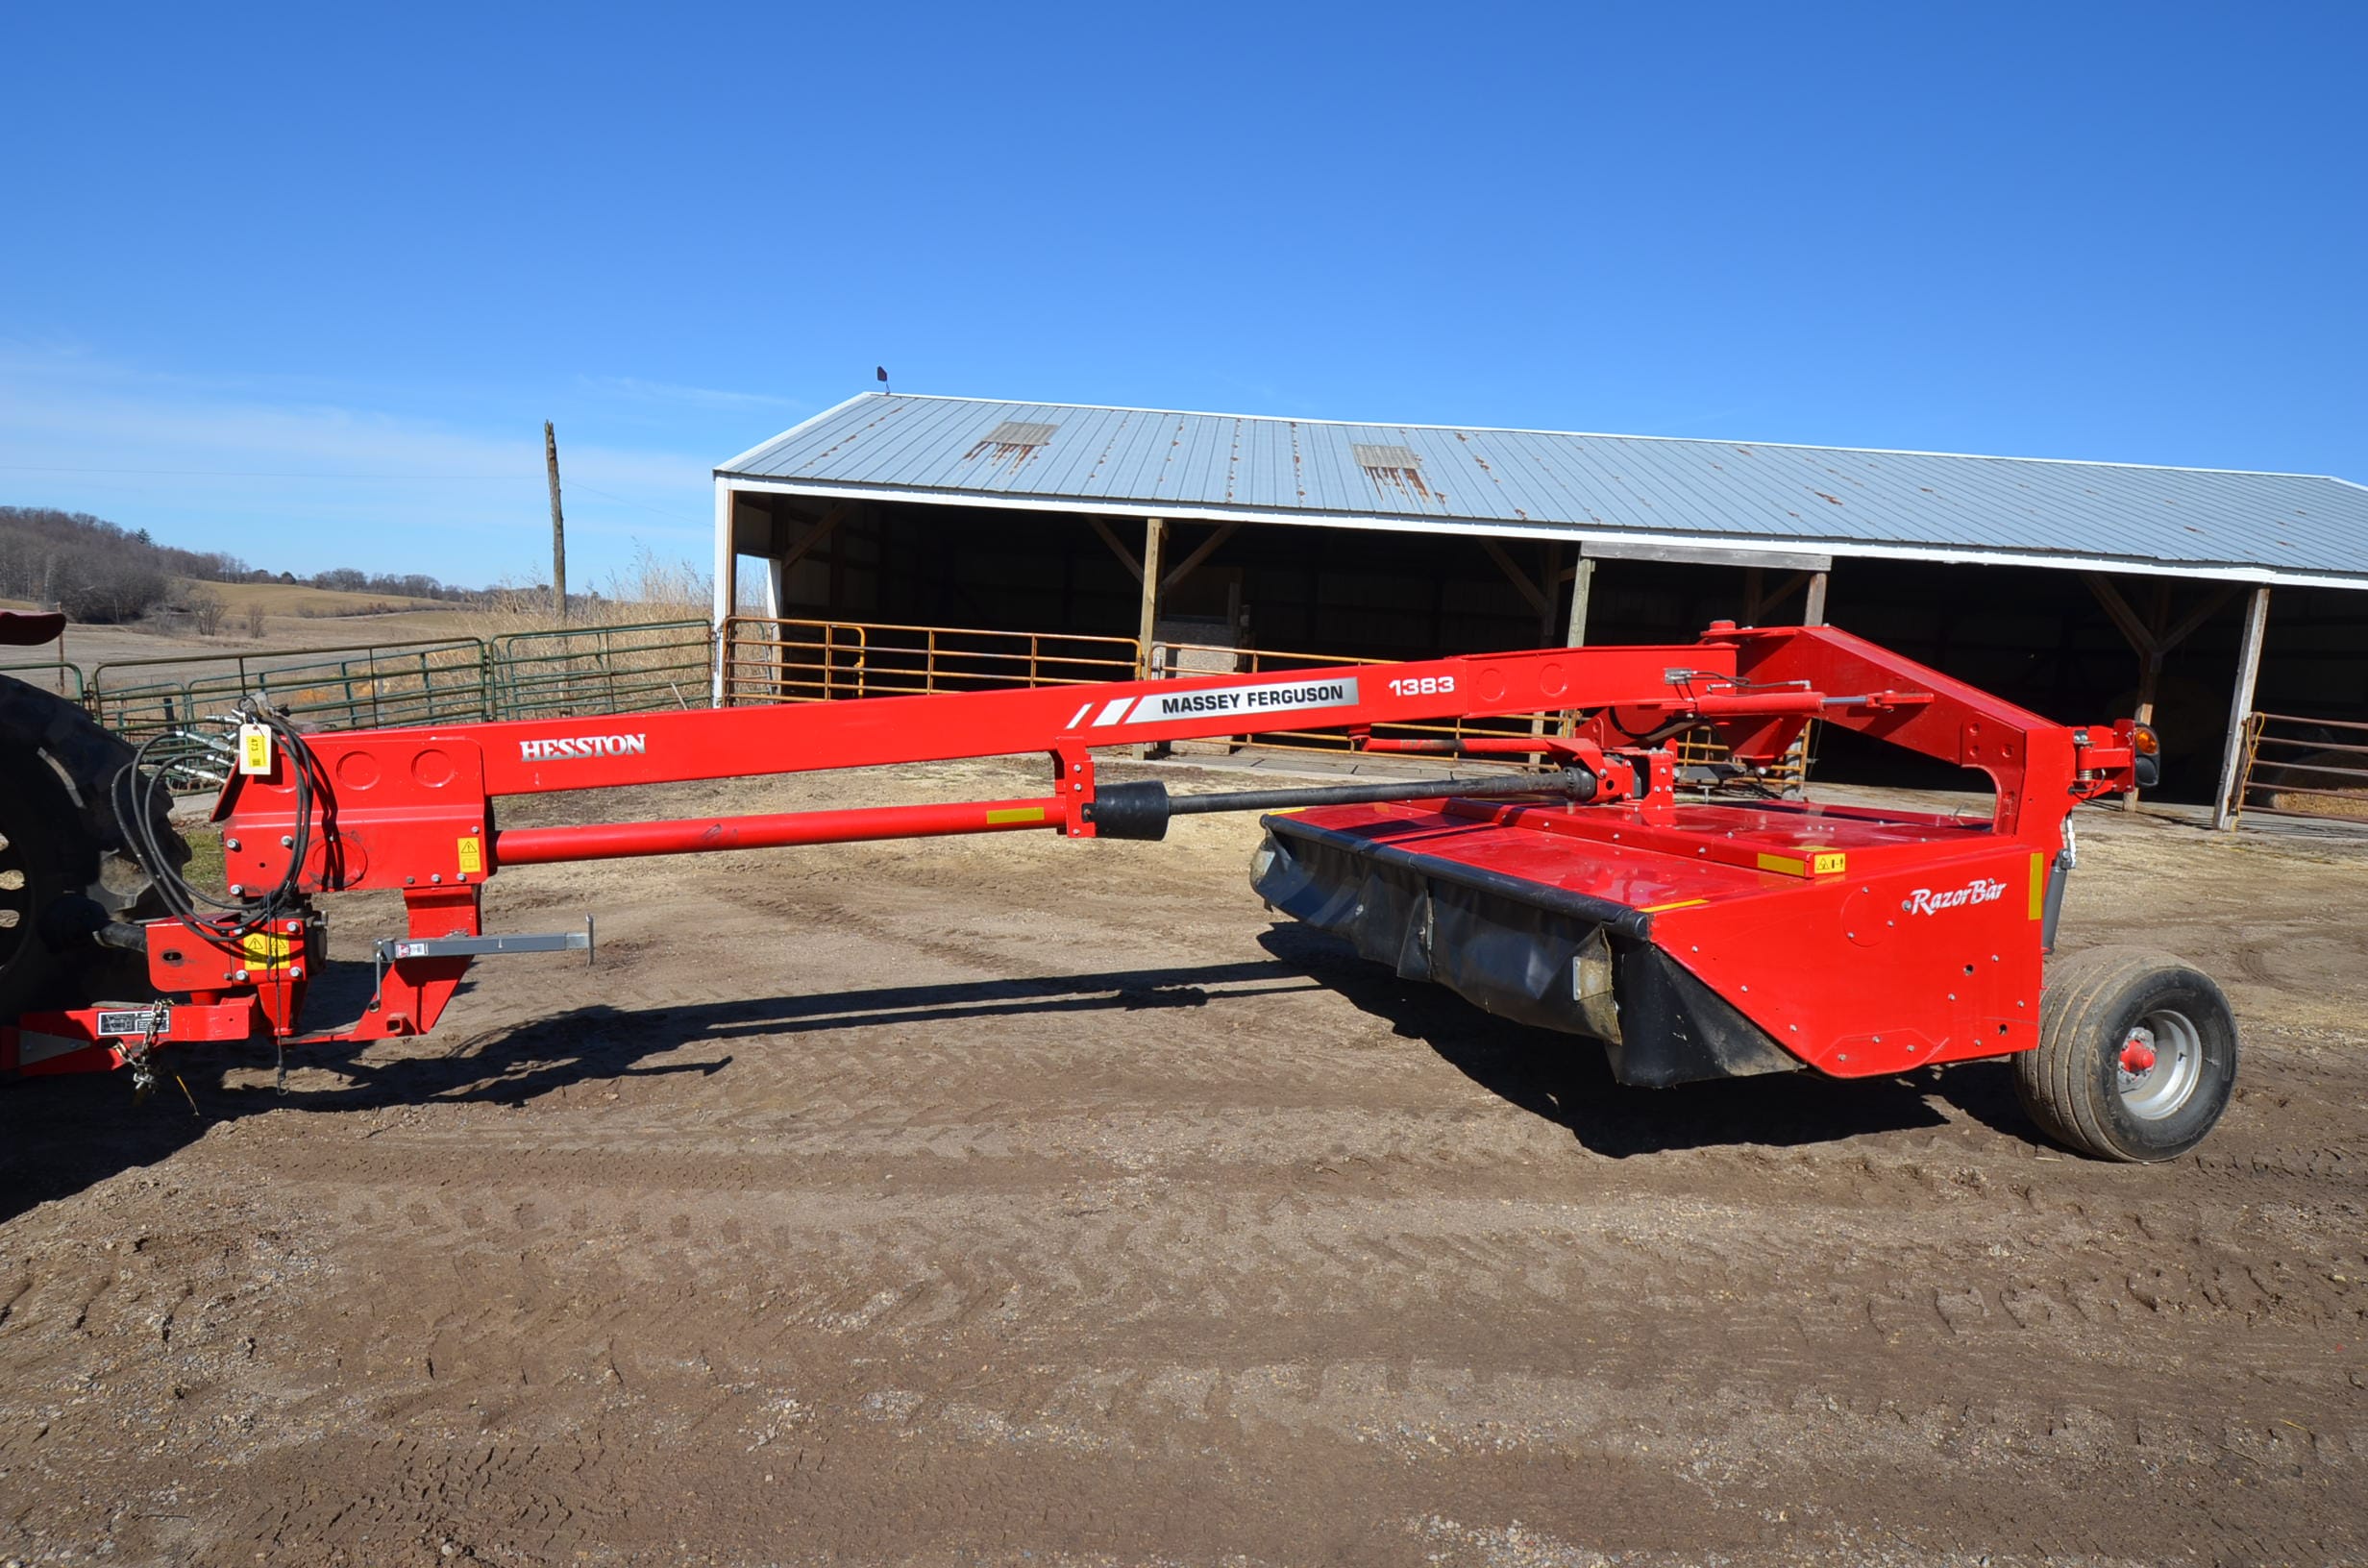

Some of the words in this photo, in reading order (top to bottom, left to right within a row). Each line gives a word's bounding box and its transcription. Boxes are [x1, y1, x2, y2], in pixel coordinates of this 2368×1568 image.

[1162, 694, 1240, 714] MASSEY
[1248, 685, 1344, 707] FERGUSON
[1389, 676, 1455, 697] 1383
[519, 733, 646, 762] HESSTON
[1910, 879, 2008, 916] RazorBar
